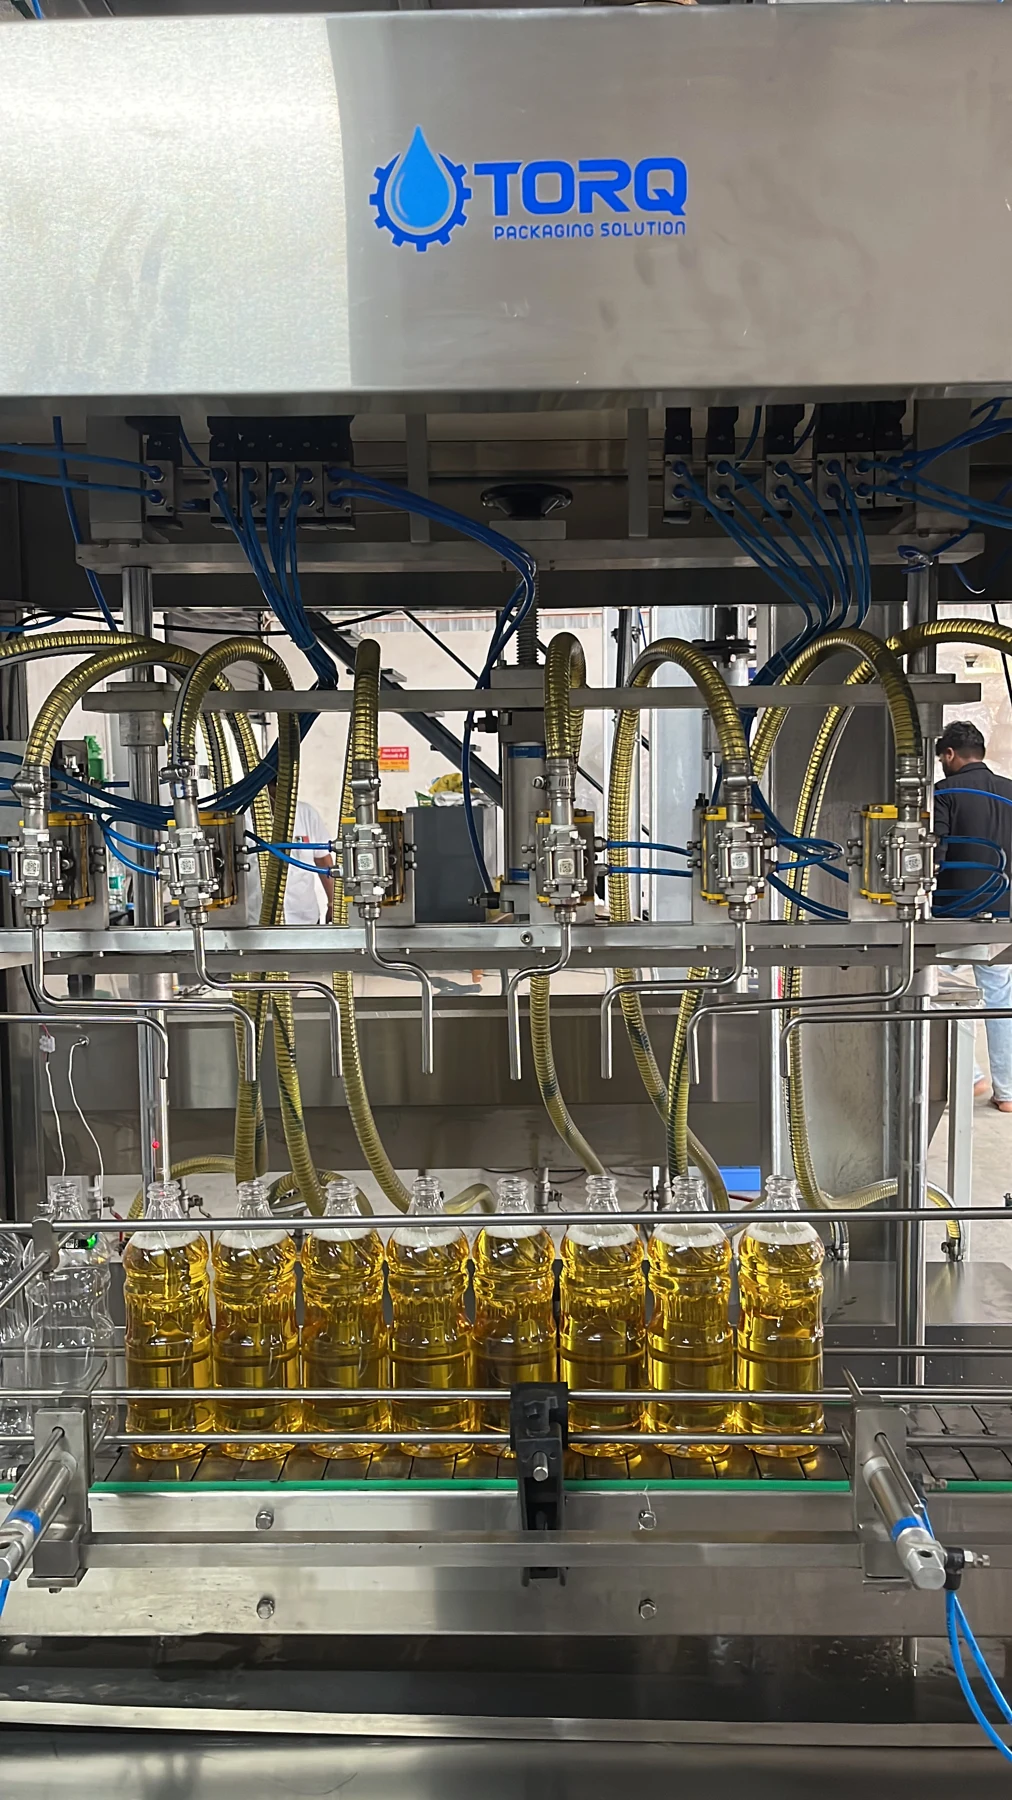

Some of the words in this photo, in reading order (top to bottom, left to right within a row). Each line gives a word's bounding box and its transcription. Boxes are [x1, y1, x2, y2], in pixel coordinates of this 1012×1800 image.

[474, 157, 688, 216] TORQ
[494, 222, 595, 240] PACKAGING
[600, 220, 687, 238] SOLUTION
